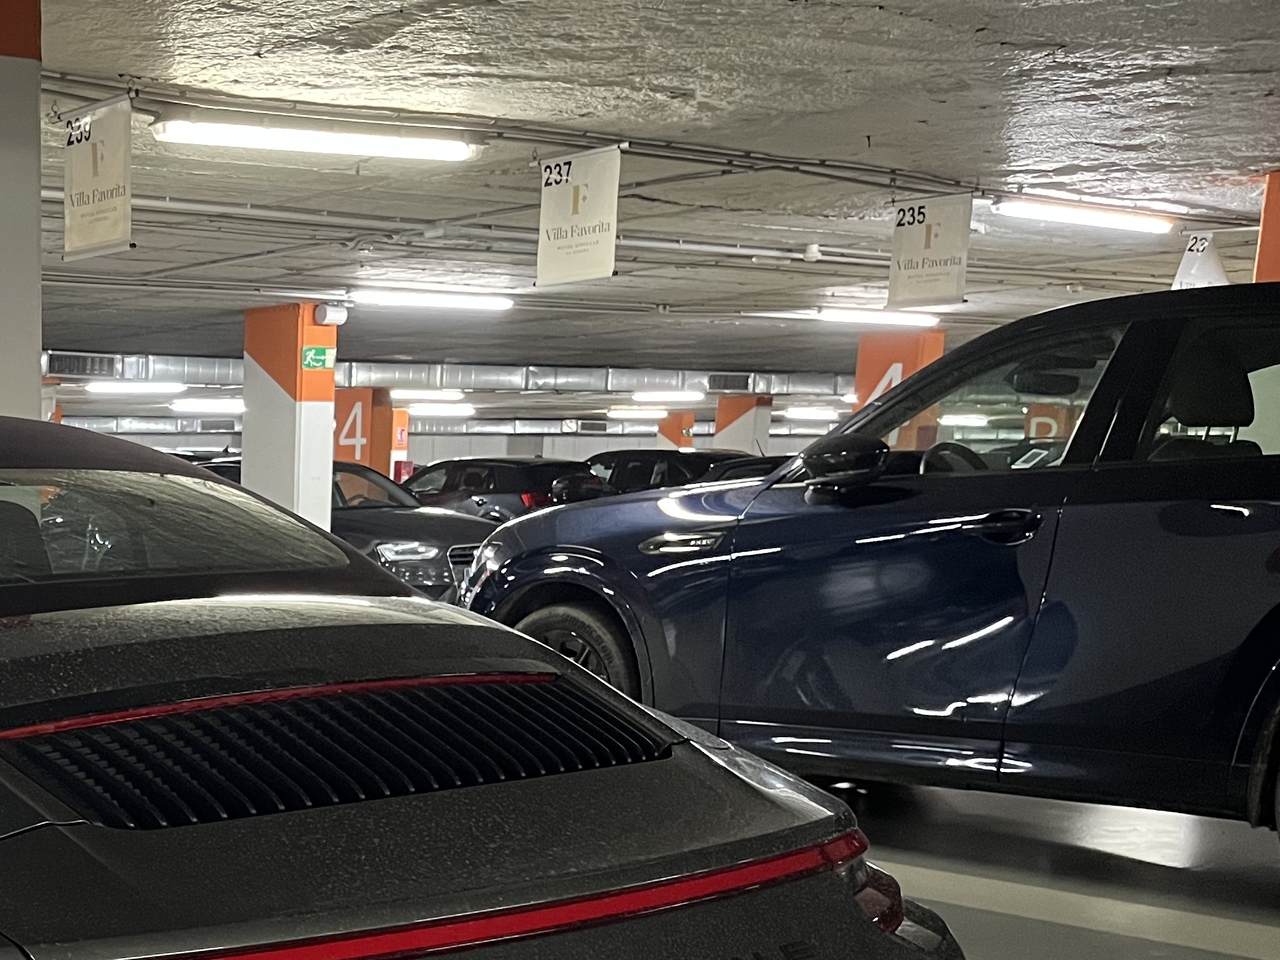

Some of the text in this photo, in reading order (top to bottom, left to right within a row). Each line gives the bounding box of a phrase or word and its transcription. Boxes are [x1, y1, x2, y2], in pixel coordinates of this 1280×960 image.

[66, 116, 91, 146] 239
[544, 161, 572, 187] 237
[70, 183, 126, 208] Villa Favorita
[895, 205, 926, 228] 235
[545, 220, 611, 241] Villa Favorita
[897, 255, 962, 271] Villa Favorita
[338, 401, 367, 461] 4
